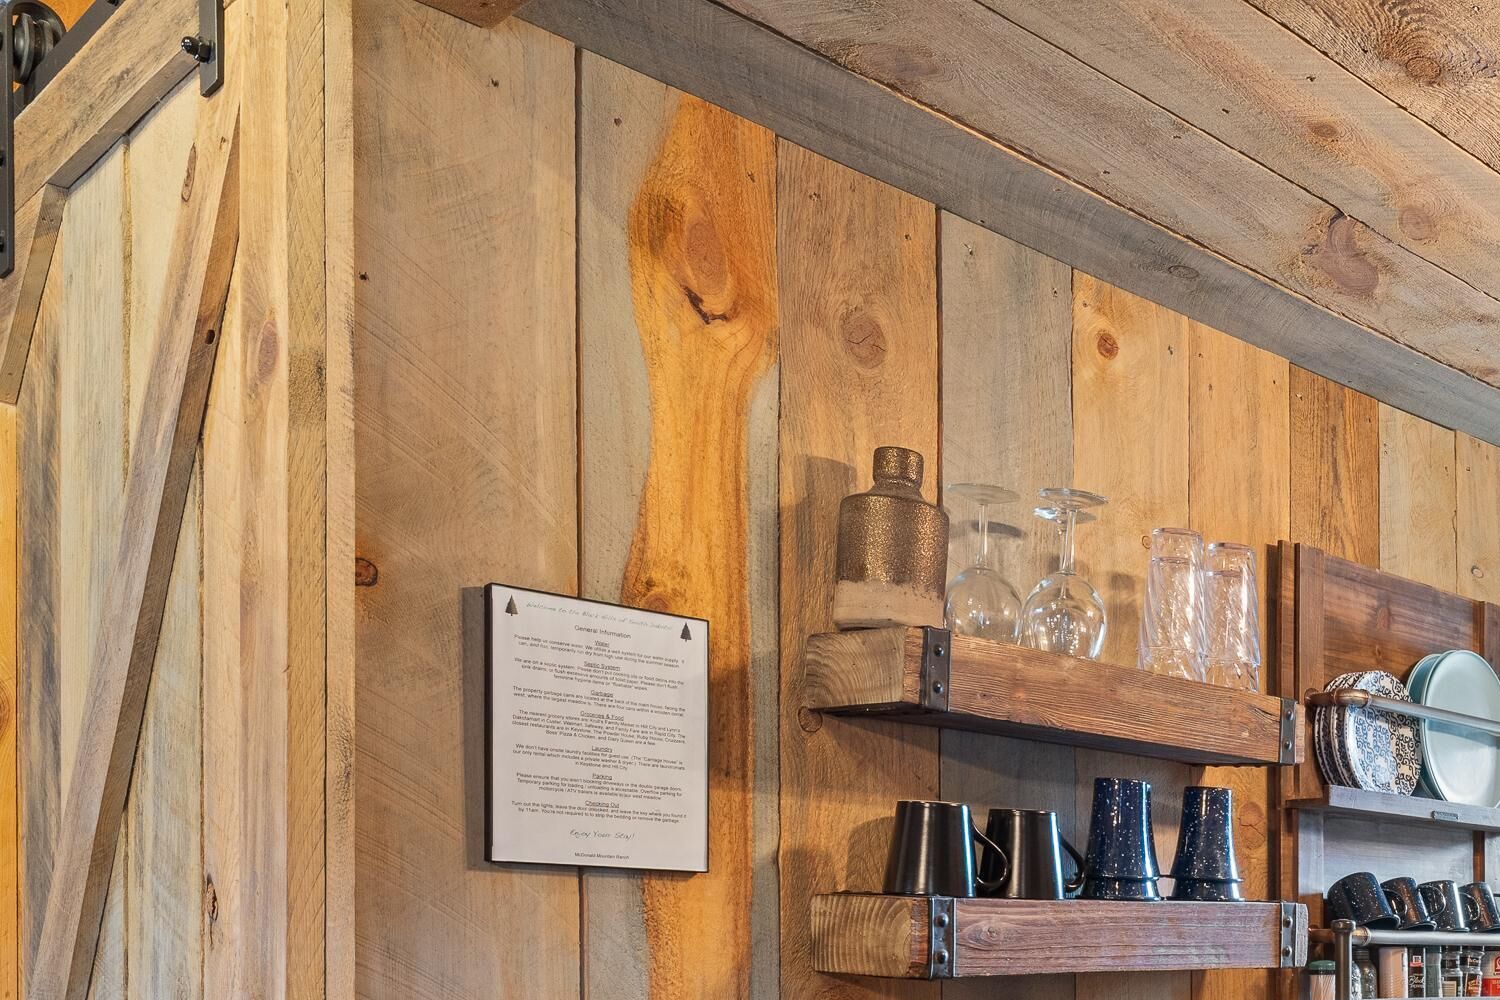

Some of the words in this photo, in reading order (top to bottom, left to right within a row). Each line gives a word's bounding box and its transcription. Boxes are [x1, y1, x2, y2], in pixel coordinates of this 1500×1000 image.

[574, 624, 597, 633] General
[599, 628, 631, 638] Information
[590, 689, 613, 698] Garbage
